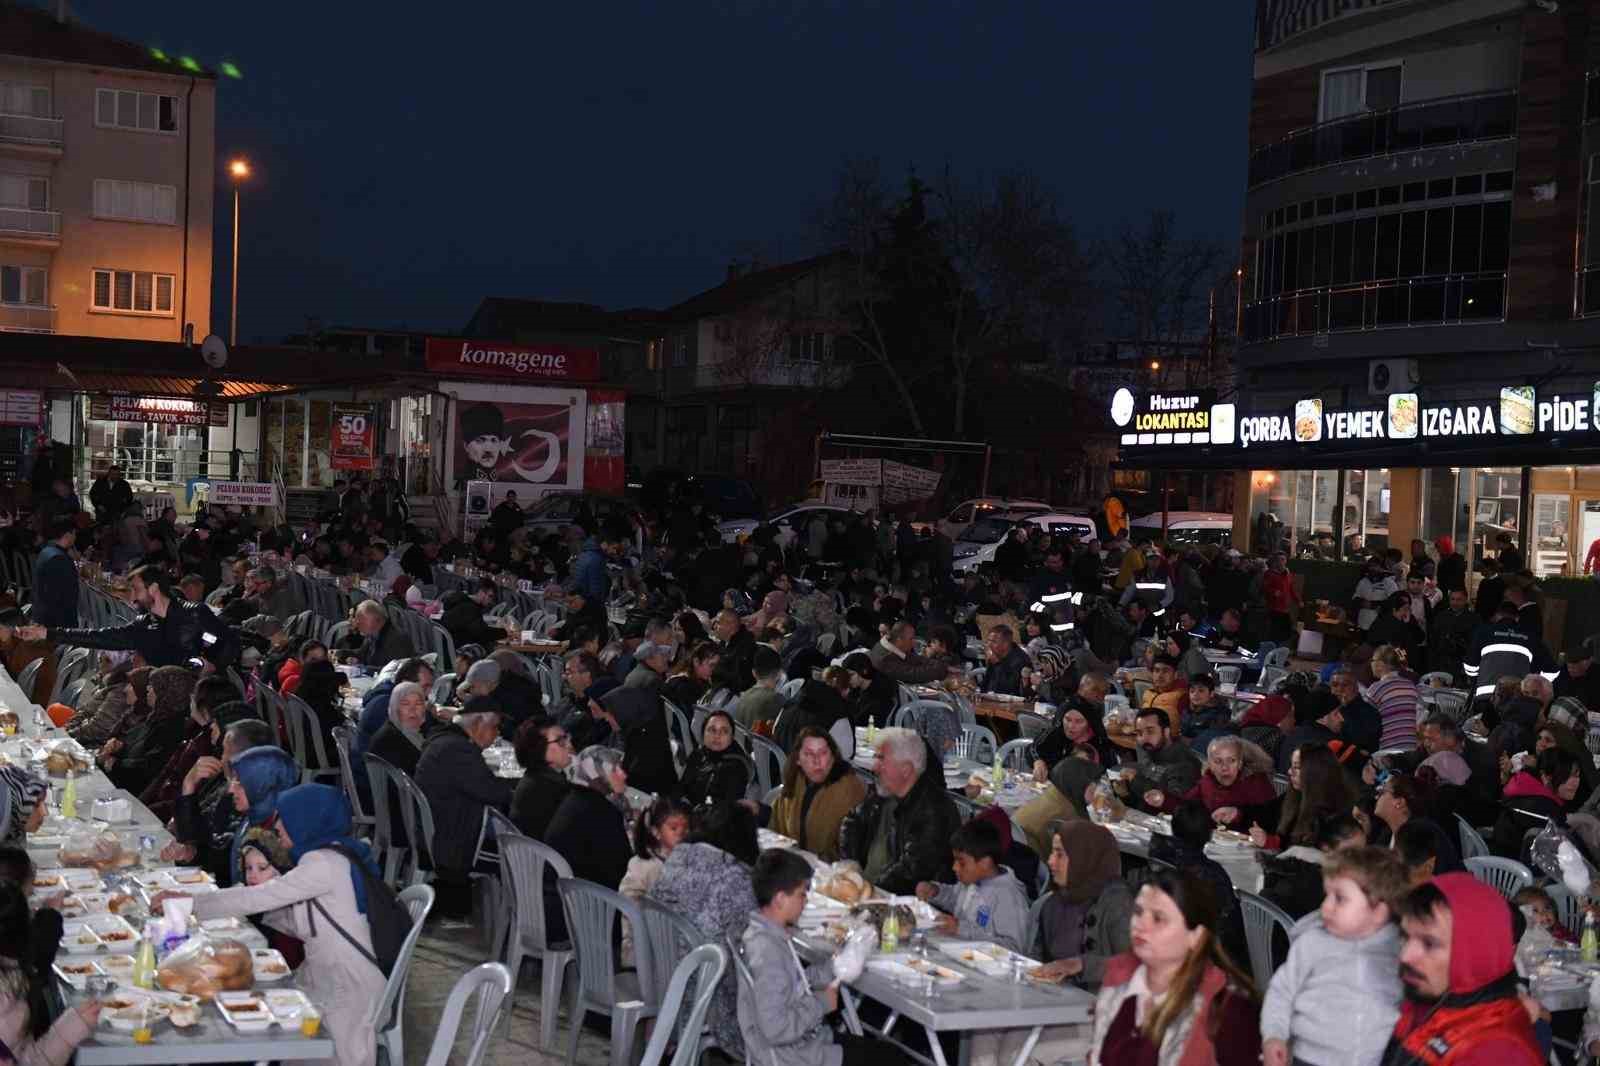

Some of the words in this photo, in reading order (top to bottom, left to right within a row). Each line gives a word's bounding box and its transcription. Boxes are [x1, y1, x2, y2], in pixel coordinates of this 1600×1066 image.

[459, 342, 566, 373] komagene
[1149, 394, 1199, 410] Huzur
[111, 408, 142, 420] KÖFTE
[147, 412, 178, 423] TAVUK
[184, 415, 208, 424] TOST
[339, 416, 366, 434] 50
[1135, 411, 1208, 430] LOKANTASI
[1239, 415, 1292, 448] ÇORBA
[1325, 411, 1385, 439] YEMEK
[1422, 406, 1497, 436] IZGARA
[1538, 395, 1589, 432] PİDE
